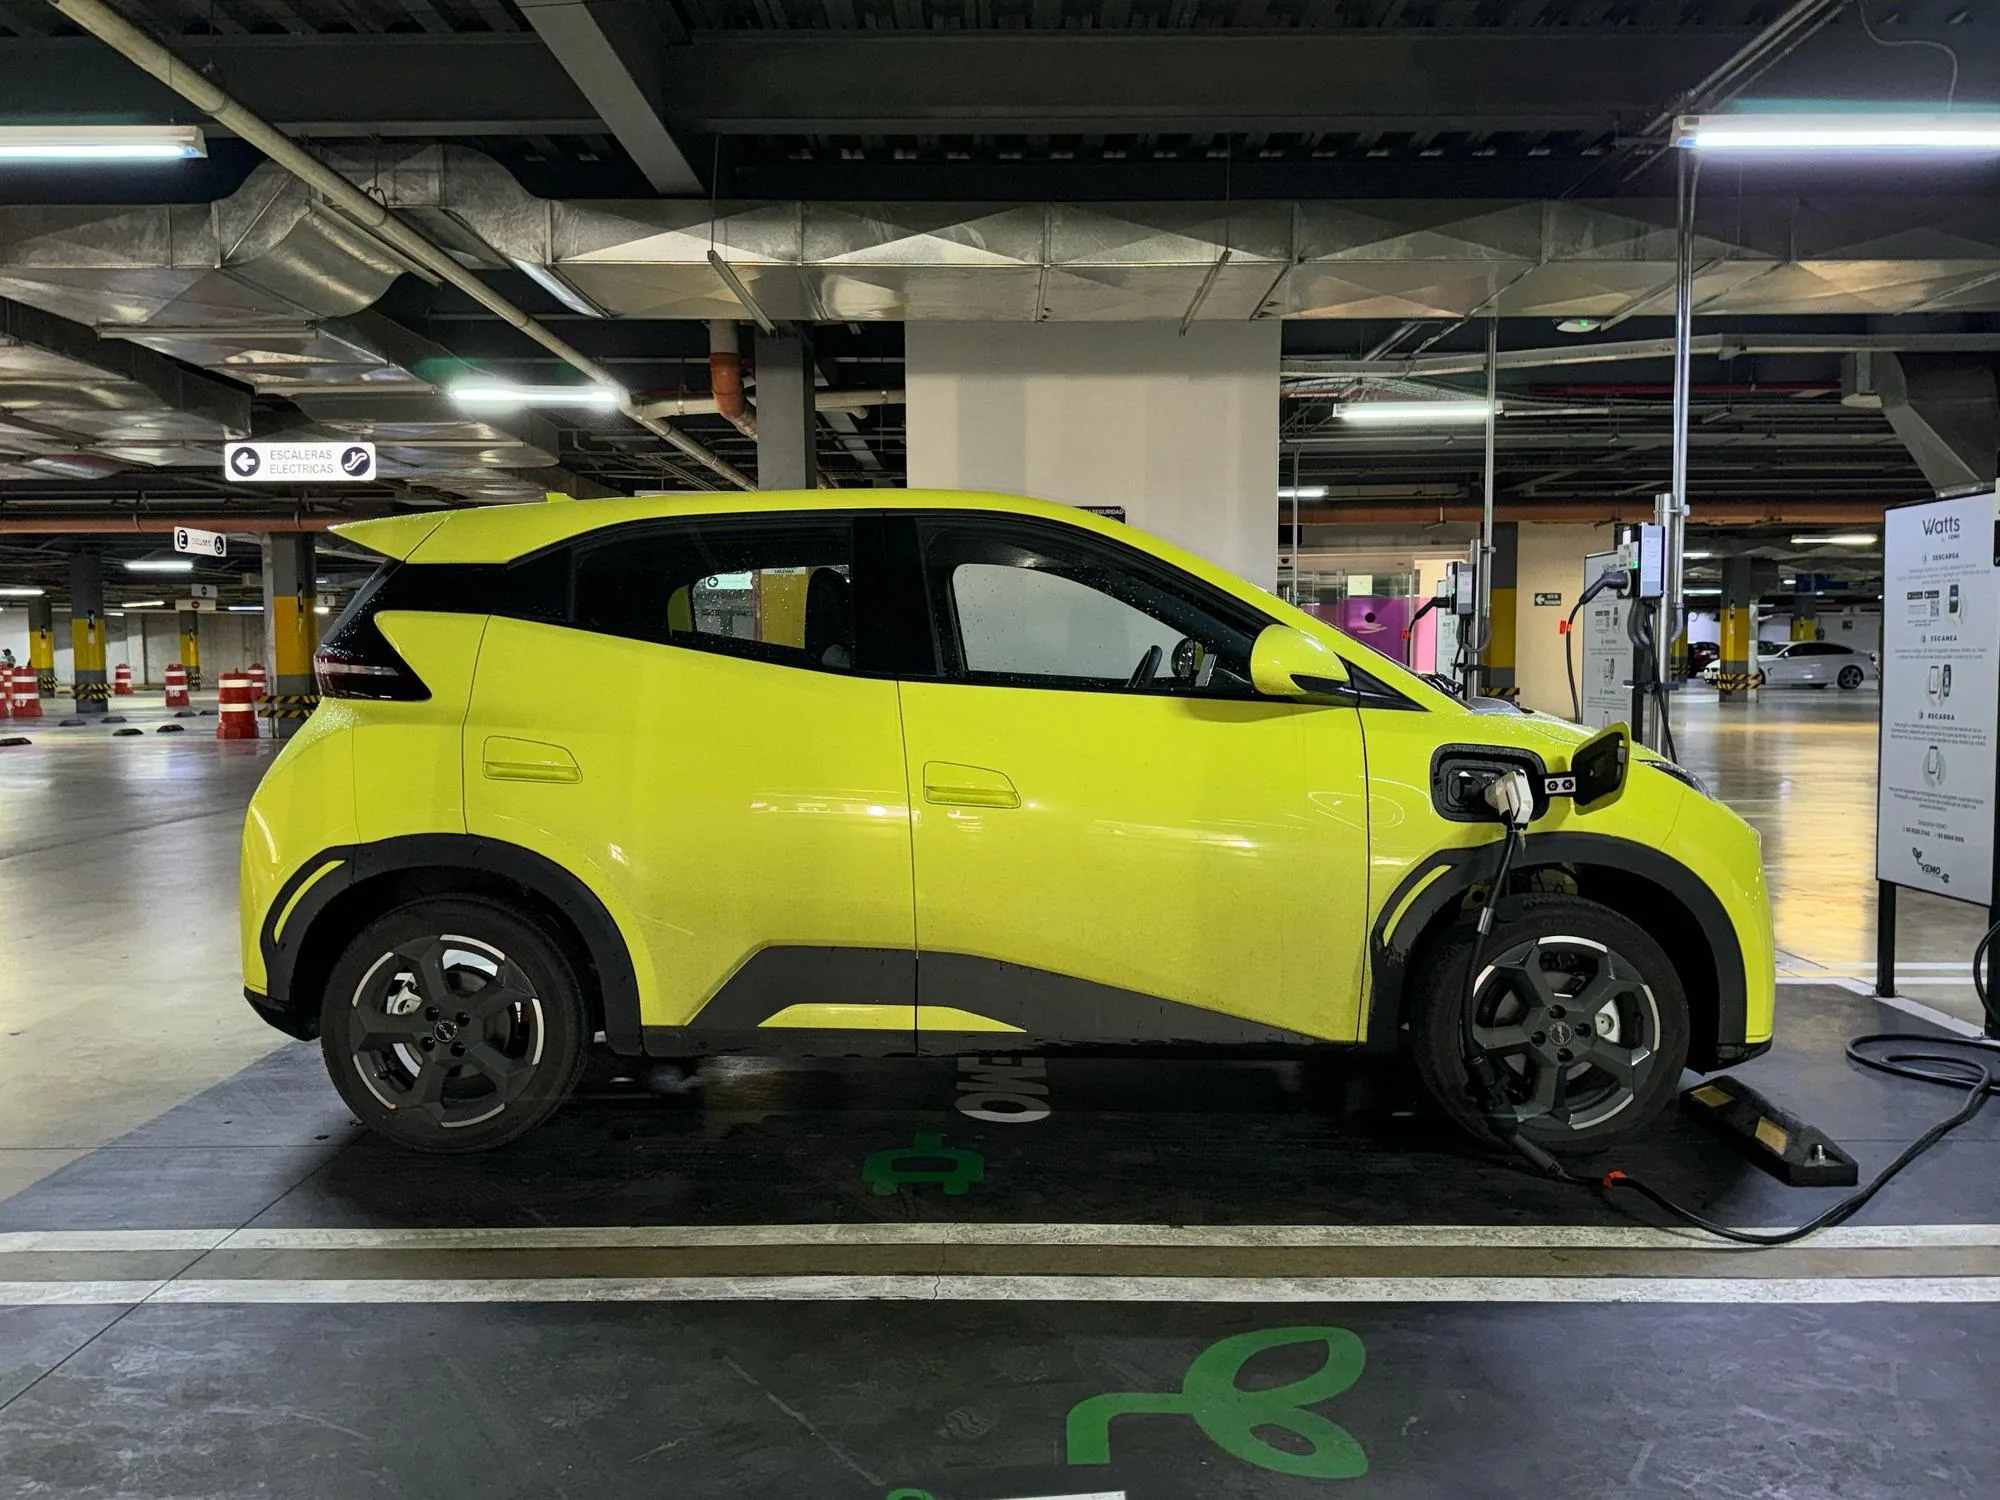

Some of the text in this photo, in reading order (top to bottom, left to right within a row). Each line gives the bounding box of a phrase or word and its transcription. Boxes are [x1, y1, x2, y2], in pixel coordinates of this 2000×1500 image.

[270, 449, 332, 461] ESCALERAS
[269, 461, 334, 475] ELÉCTRICAS
[1922, 515, 1960, 536] Watts
[180, 531, 187, 548] E
[1932, 552, 1959, 561] DESCARGA
[1930, 634, 1958, 642] ESCANEA
[1927, 712, 1955, 721] RECARGA
[1921, 863, 1941, 876] VEMO
